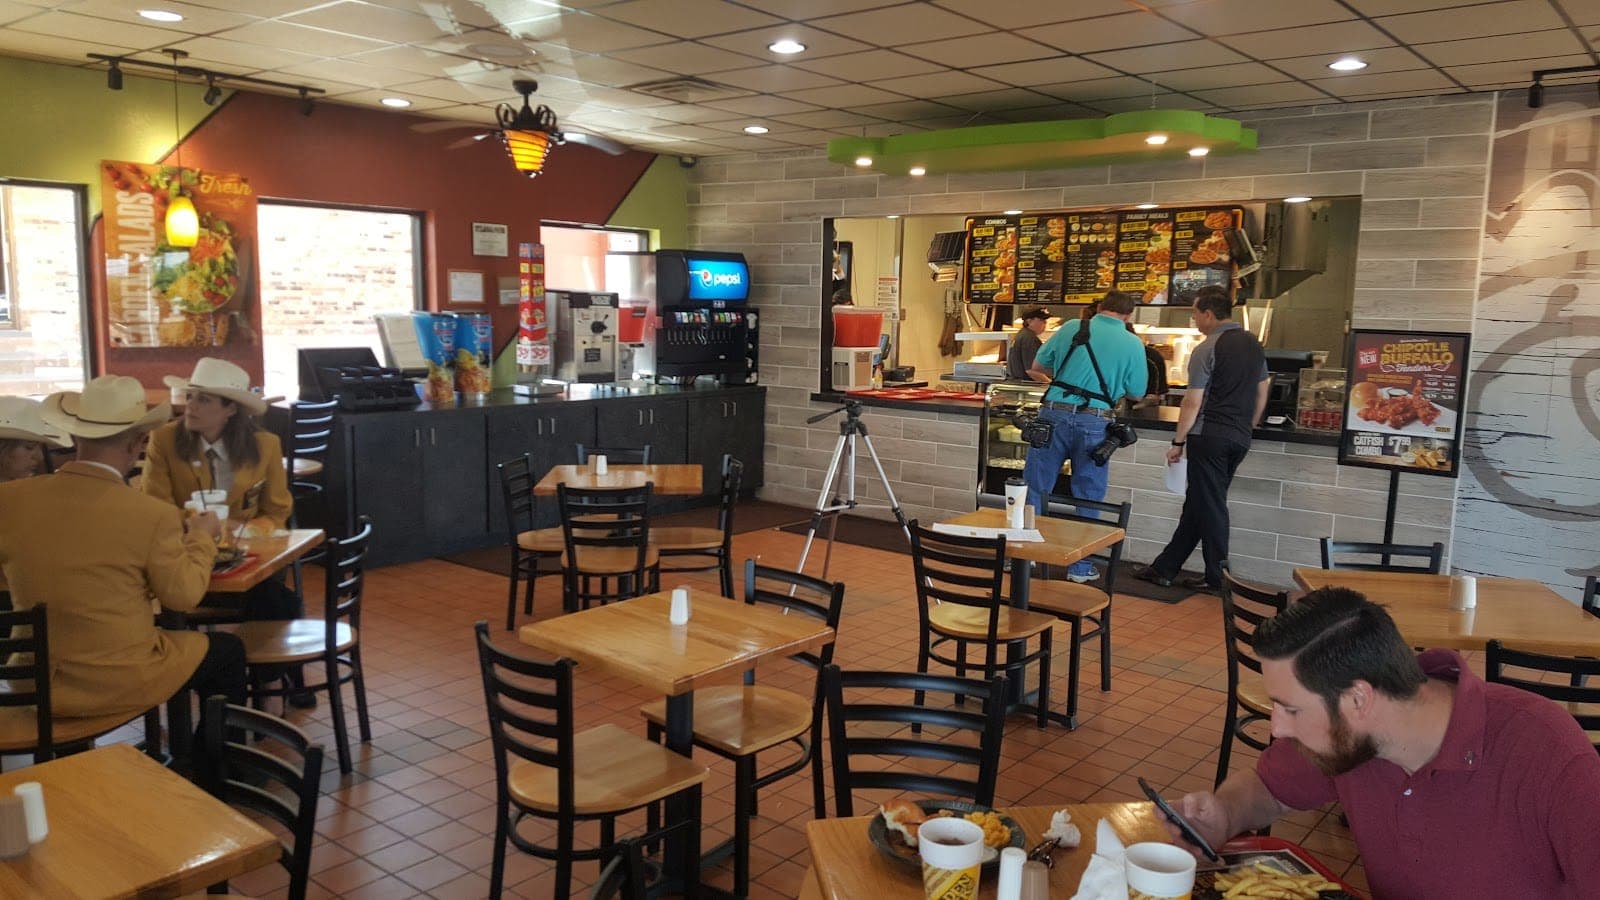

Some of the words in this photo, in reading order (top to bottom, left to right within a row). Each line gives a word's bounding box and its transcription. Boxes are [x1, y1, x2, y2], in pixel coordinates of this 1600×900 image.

[713, 272, 741, 287] pepsi
[1383, 342, 1449, 353] CHIPOTLE
[1360, 354, 1377, 365] NEW
[1381, 352, 1454, 365] BUFFALO
[1353, 436, 1385, 446] CATFISH
[1355, 446, 1383, 456] COMBO
